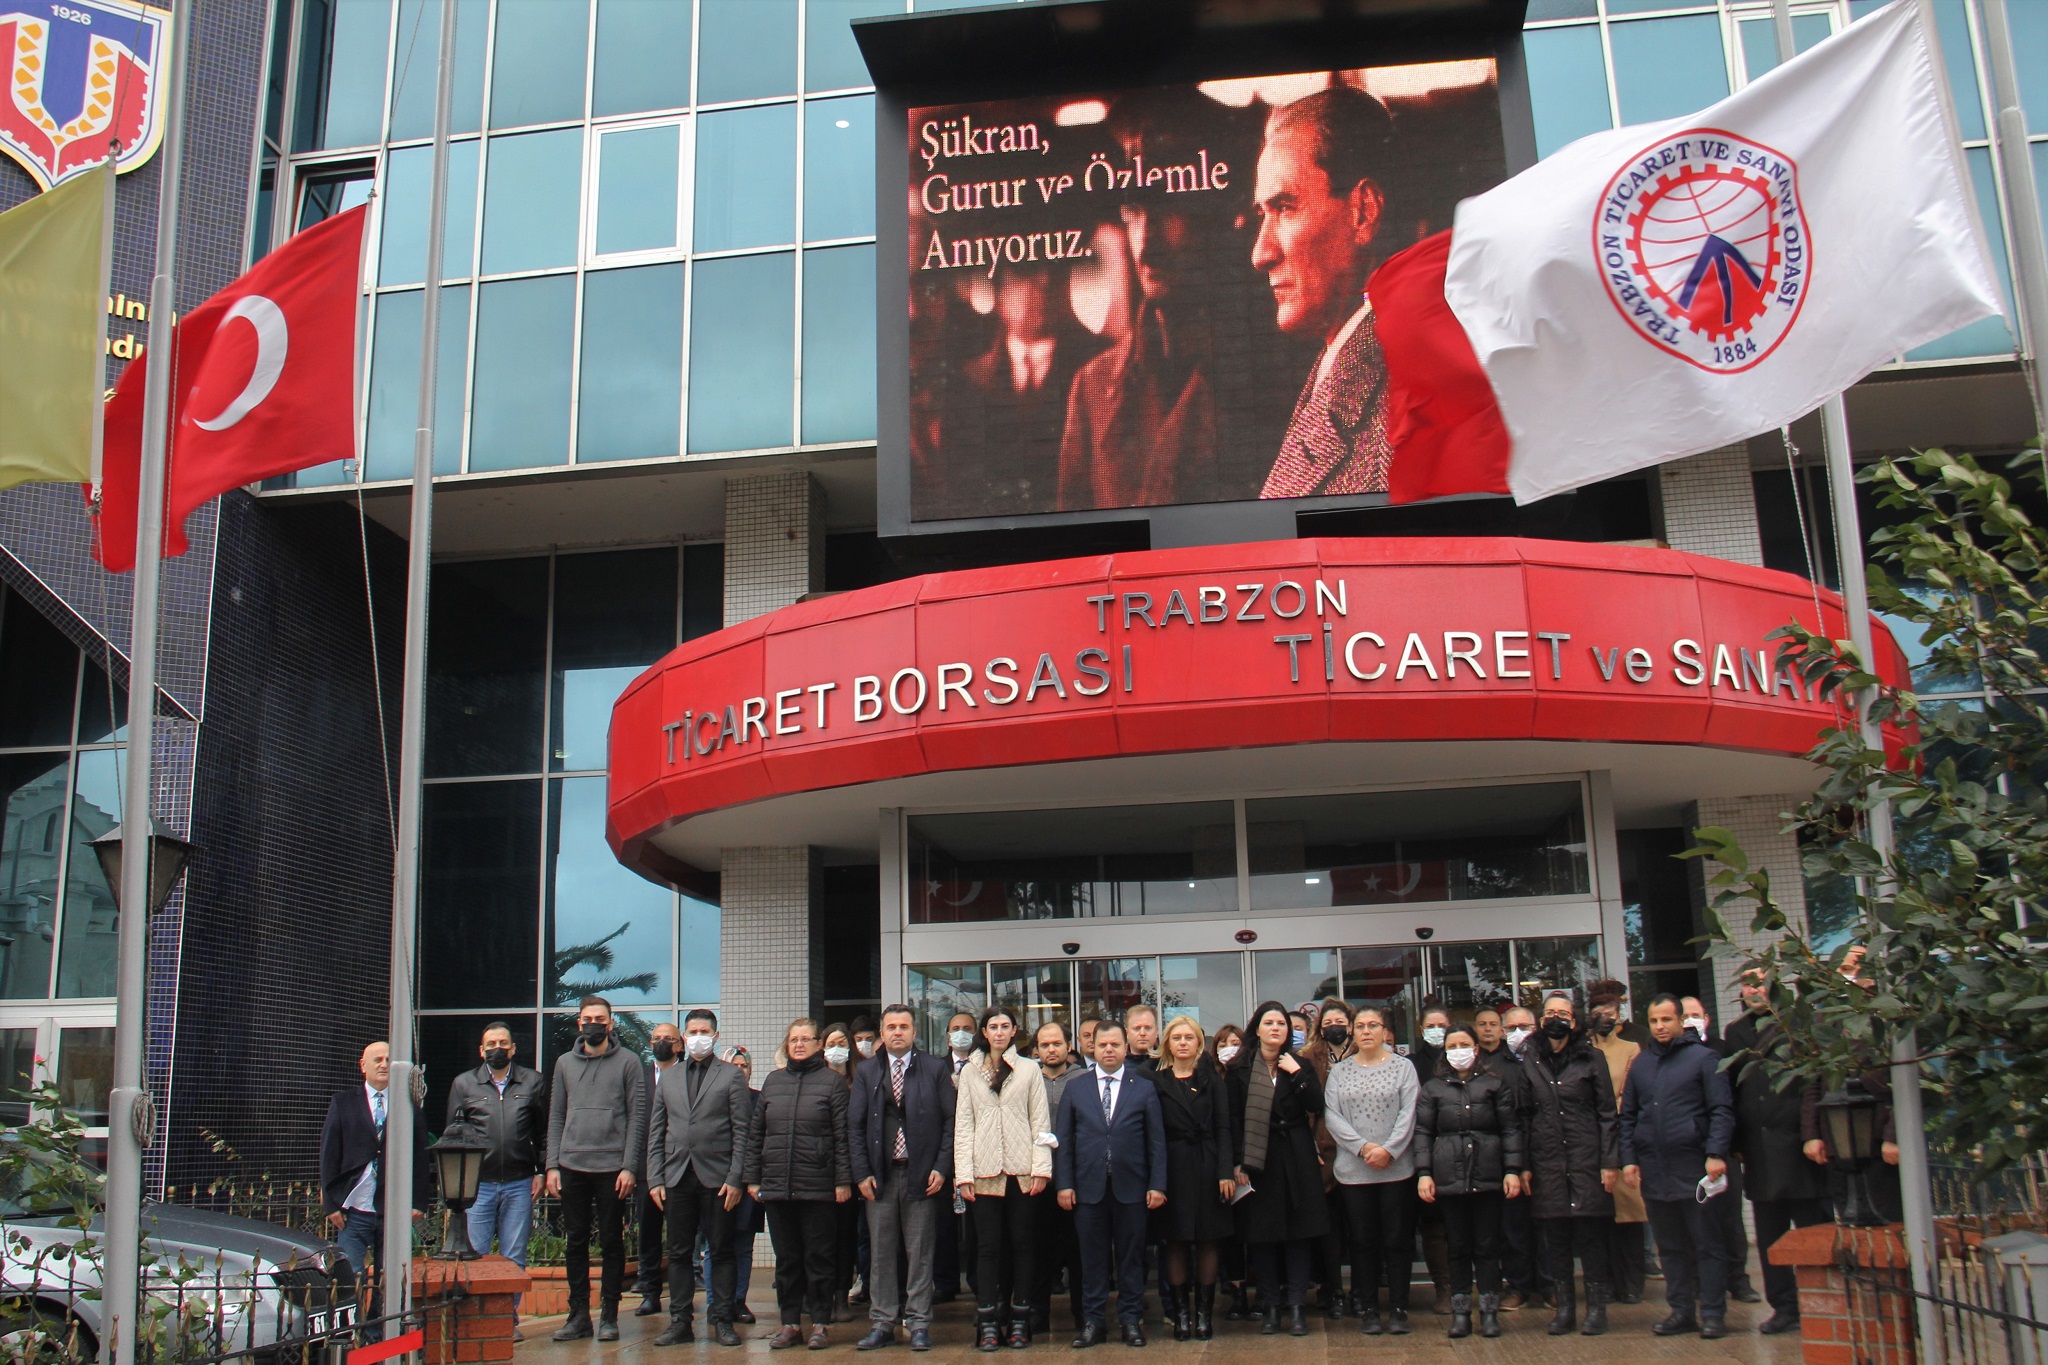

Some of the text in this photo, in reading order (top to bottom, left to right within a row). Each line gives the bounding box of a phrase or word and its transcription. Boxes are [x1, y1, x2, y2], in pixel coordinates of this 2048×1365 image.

[50, 4, 92, 26] 1926
[920, 115, 1049, 171] Şükran,
[1699, 140, 1729, 160] VE
[921, 149, 1229, 214] Gurur ve Özlemle
[1604, 141, 1691, 225] TİCARET
[920, 229, 1092, 280] Anıyoruz.
[1776, 225, 1803, 308] ODASI
[1603, 234, 1680, 345] TRABZON
[1713, 337, 1757, 364] 1884
[1087, 579, 1347, 632] TRABZON
[1273, 622, 1835, 703] TİCARET ve SANA
[662, 644, 1134, 764] TİCARET BORSASI
